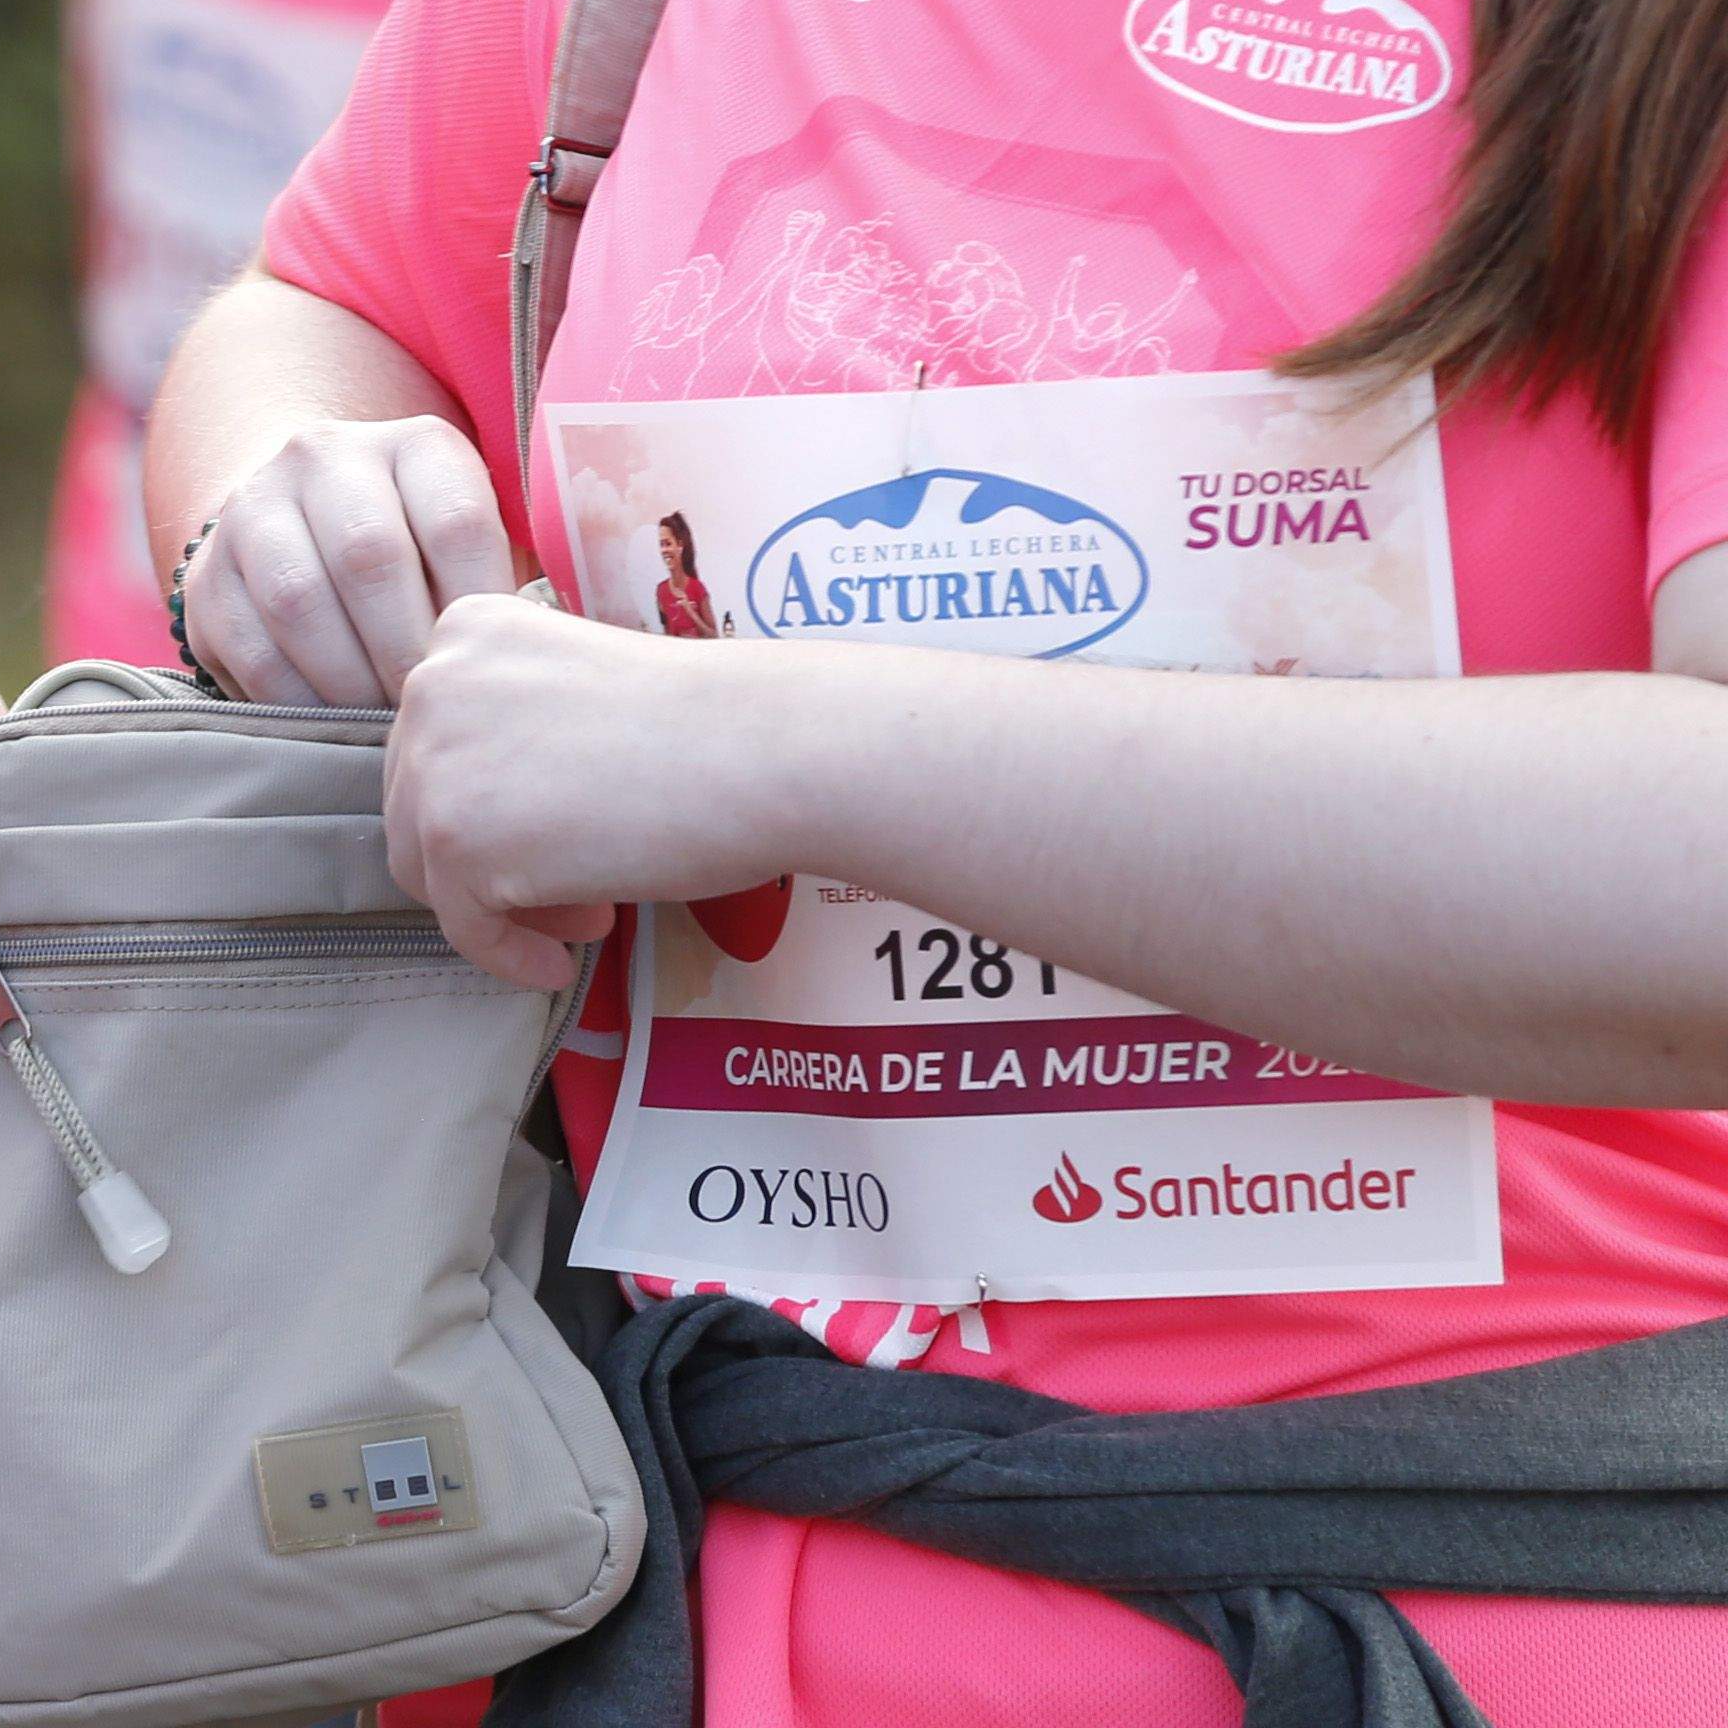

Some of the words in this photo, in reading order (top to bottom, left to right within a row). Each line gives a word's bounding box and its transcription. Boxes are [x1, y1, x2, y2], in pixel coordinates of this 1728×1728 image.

[1210, 3, 1313, 37] CENTRAL
[1321, 22, 1422, 55] LECHERA
[1179, 473, 1222, 499] TU
[1232, 466, 1370, 497] DORSAL
[830, 540, 959, 565] CENTRAL
[970, 532, 1102, 557] LECHERA
[1184, 498, 1371, 550] SUMA
[775, 551, 1119, 628] ASTURIANA
[725, 1045, 869, 1093] CARRERA
[880, 1052, 945, 1093] DE
[958, 1048, 1027, 1091] LA
[1042, 1040, 1232, 1088] MUJER
[688, 1164, 889, 1233] OYSHO
[1112, 1158, 1417, 1220] Santander
